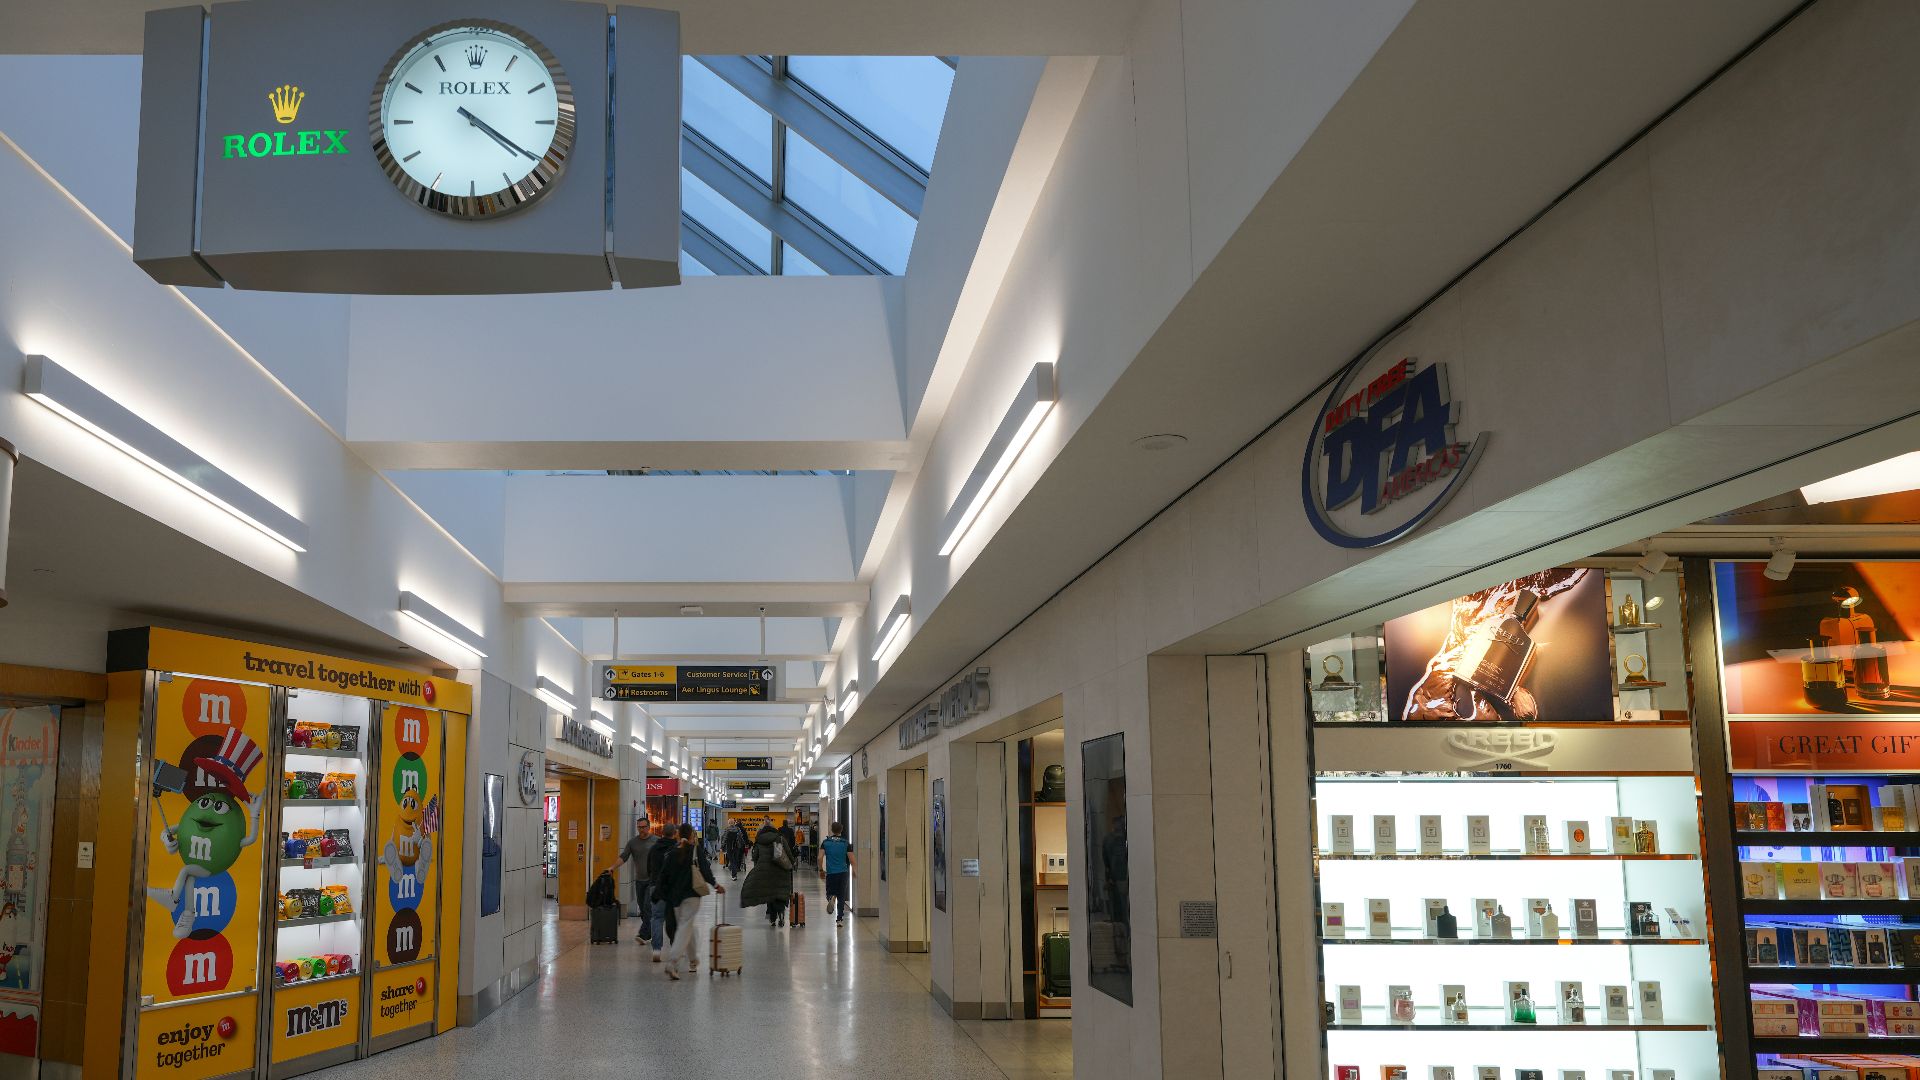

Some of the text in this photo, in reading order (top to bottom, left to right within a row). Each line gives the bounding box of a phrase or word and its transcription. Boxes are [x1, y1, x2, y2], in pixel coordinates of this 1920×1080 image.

[439, 81, 511, 95] ROLEX
[221, 129, 350, 159] ROLEX
[1325, 358, 1410, 433] DUTY FREE
[1323, 363, 1451, 516] DFA
[243, 651, 315, 679] travel
[318, 663, 396, 691] together
[398, 678, 421, 697] with
[697, 686, 720, 694] Lingus
[721, 686, 748, 694] Lounge
[1447, 729, 1559, 748] CREED
[1779, 735, 1863, 754] GREAT
[381, 984, 415, 1001] share
[380, 998, 418, 1019] together
[157, 1022, 215, 1046] enjoy
[156, 1042, 226, 1069] together
